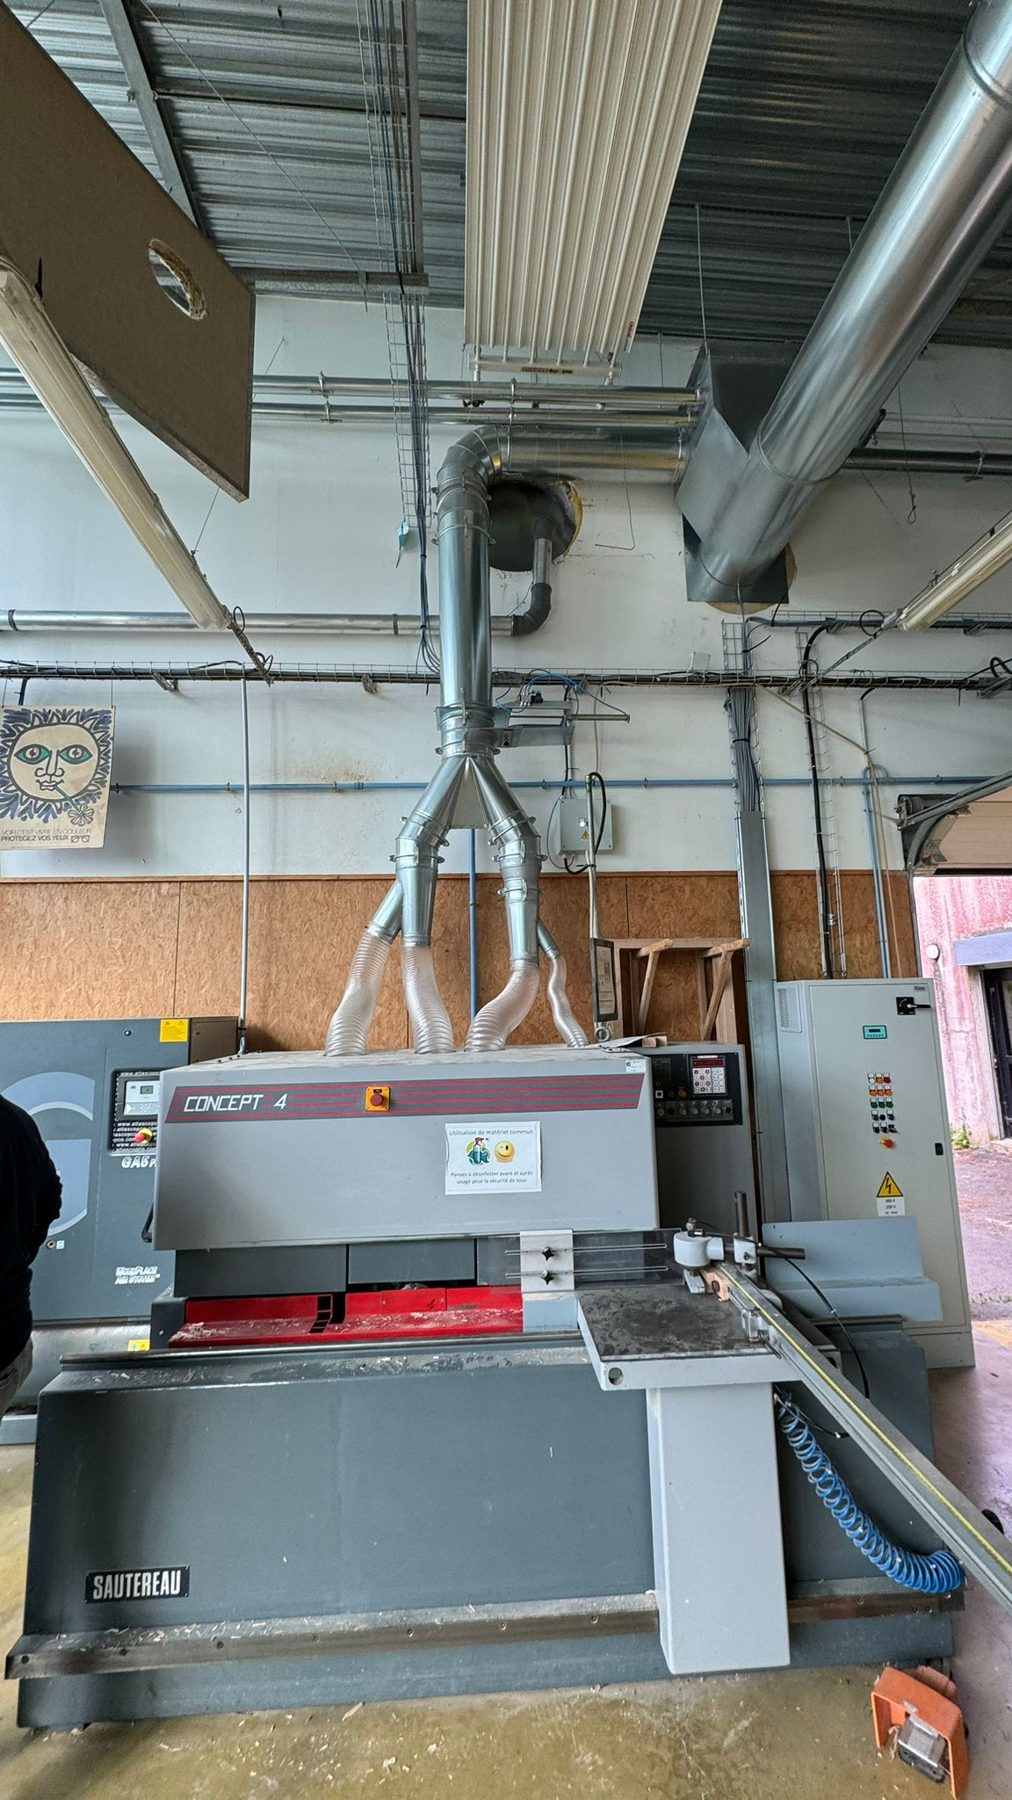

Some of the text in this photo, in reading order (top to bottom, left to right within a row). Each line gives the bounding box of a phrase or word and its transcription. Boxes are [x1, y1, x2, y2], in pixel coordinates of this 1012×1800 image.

[183, 1093, 288, 1112] CONCEPT 4
[93, 1570, 181, 1599] SAUTEREAU
